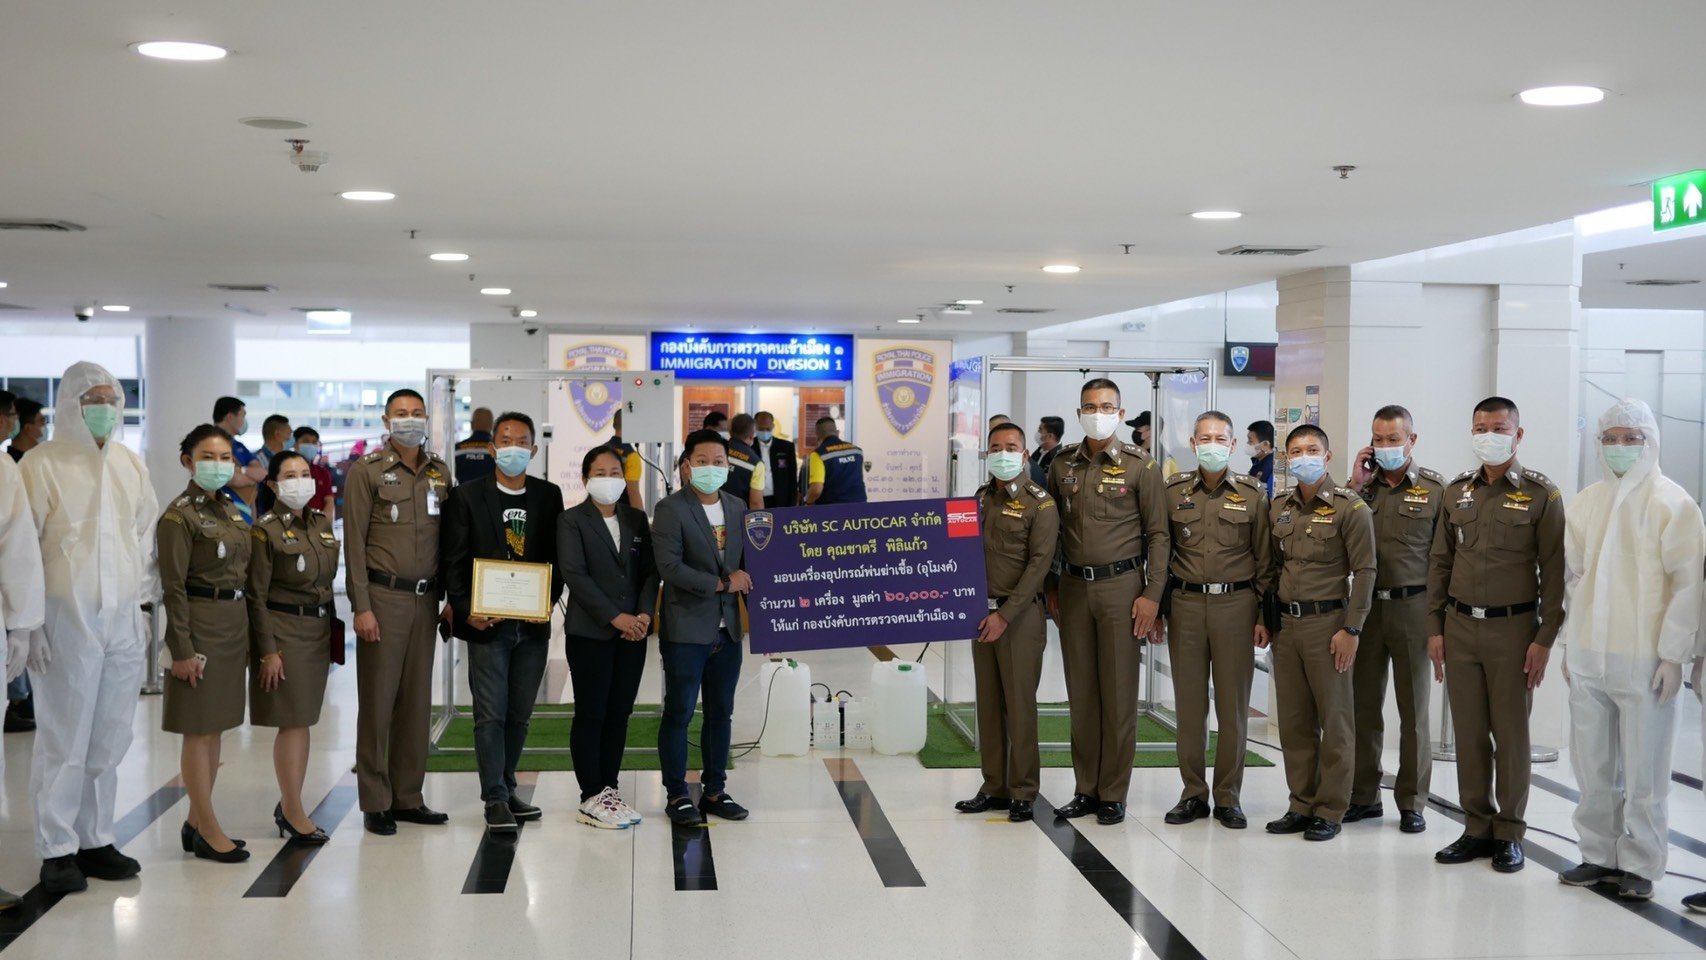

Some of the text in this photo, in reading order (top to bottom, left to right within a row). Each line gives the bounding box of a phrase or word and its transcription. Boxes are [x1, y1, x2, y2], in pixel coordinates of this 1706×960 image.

[660, 337, 830, 355] กองบังคับการตรวจคนเข้าเมือง
[877, 350, 896, 362] ROYAL
[911, 351, 932, 363] POLICE
[660, 358, 842, 370] IMMIGRATION DIVISION 1
[877, 370, 932, 382] IMMIGRATION
[783, 519, 817, 535] บริษัท
[822, 520, 838, 532] SC
[842, 516, 907, 531] AUTOCAR
[911, 511, 942, 527] จำกัด
[799, 543, 822, 558] โดย
[827, 538, 877, 560] คุณชาตรี
[774, 559, 958, 583] มอบเครื่องอุปกรณ์พ่นฆ่าเชื้อ (อุโมงค์)
[760, 597, 795, 610] จำนวน
[814, 590, 845, 607] เครื่อง
[852, 590, 881, 608] มูลค่า
[953, 587, 976, 597] บาท
[771, 618, 799, 632] ให้แก่
[803, 608, 954, 630] กองบังคับการตรวจคนเข้าเมือง
